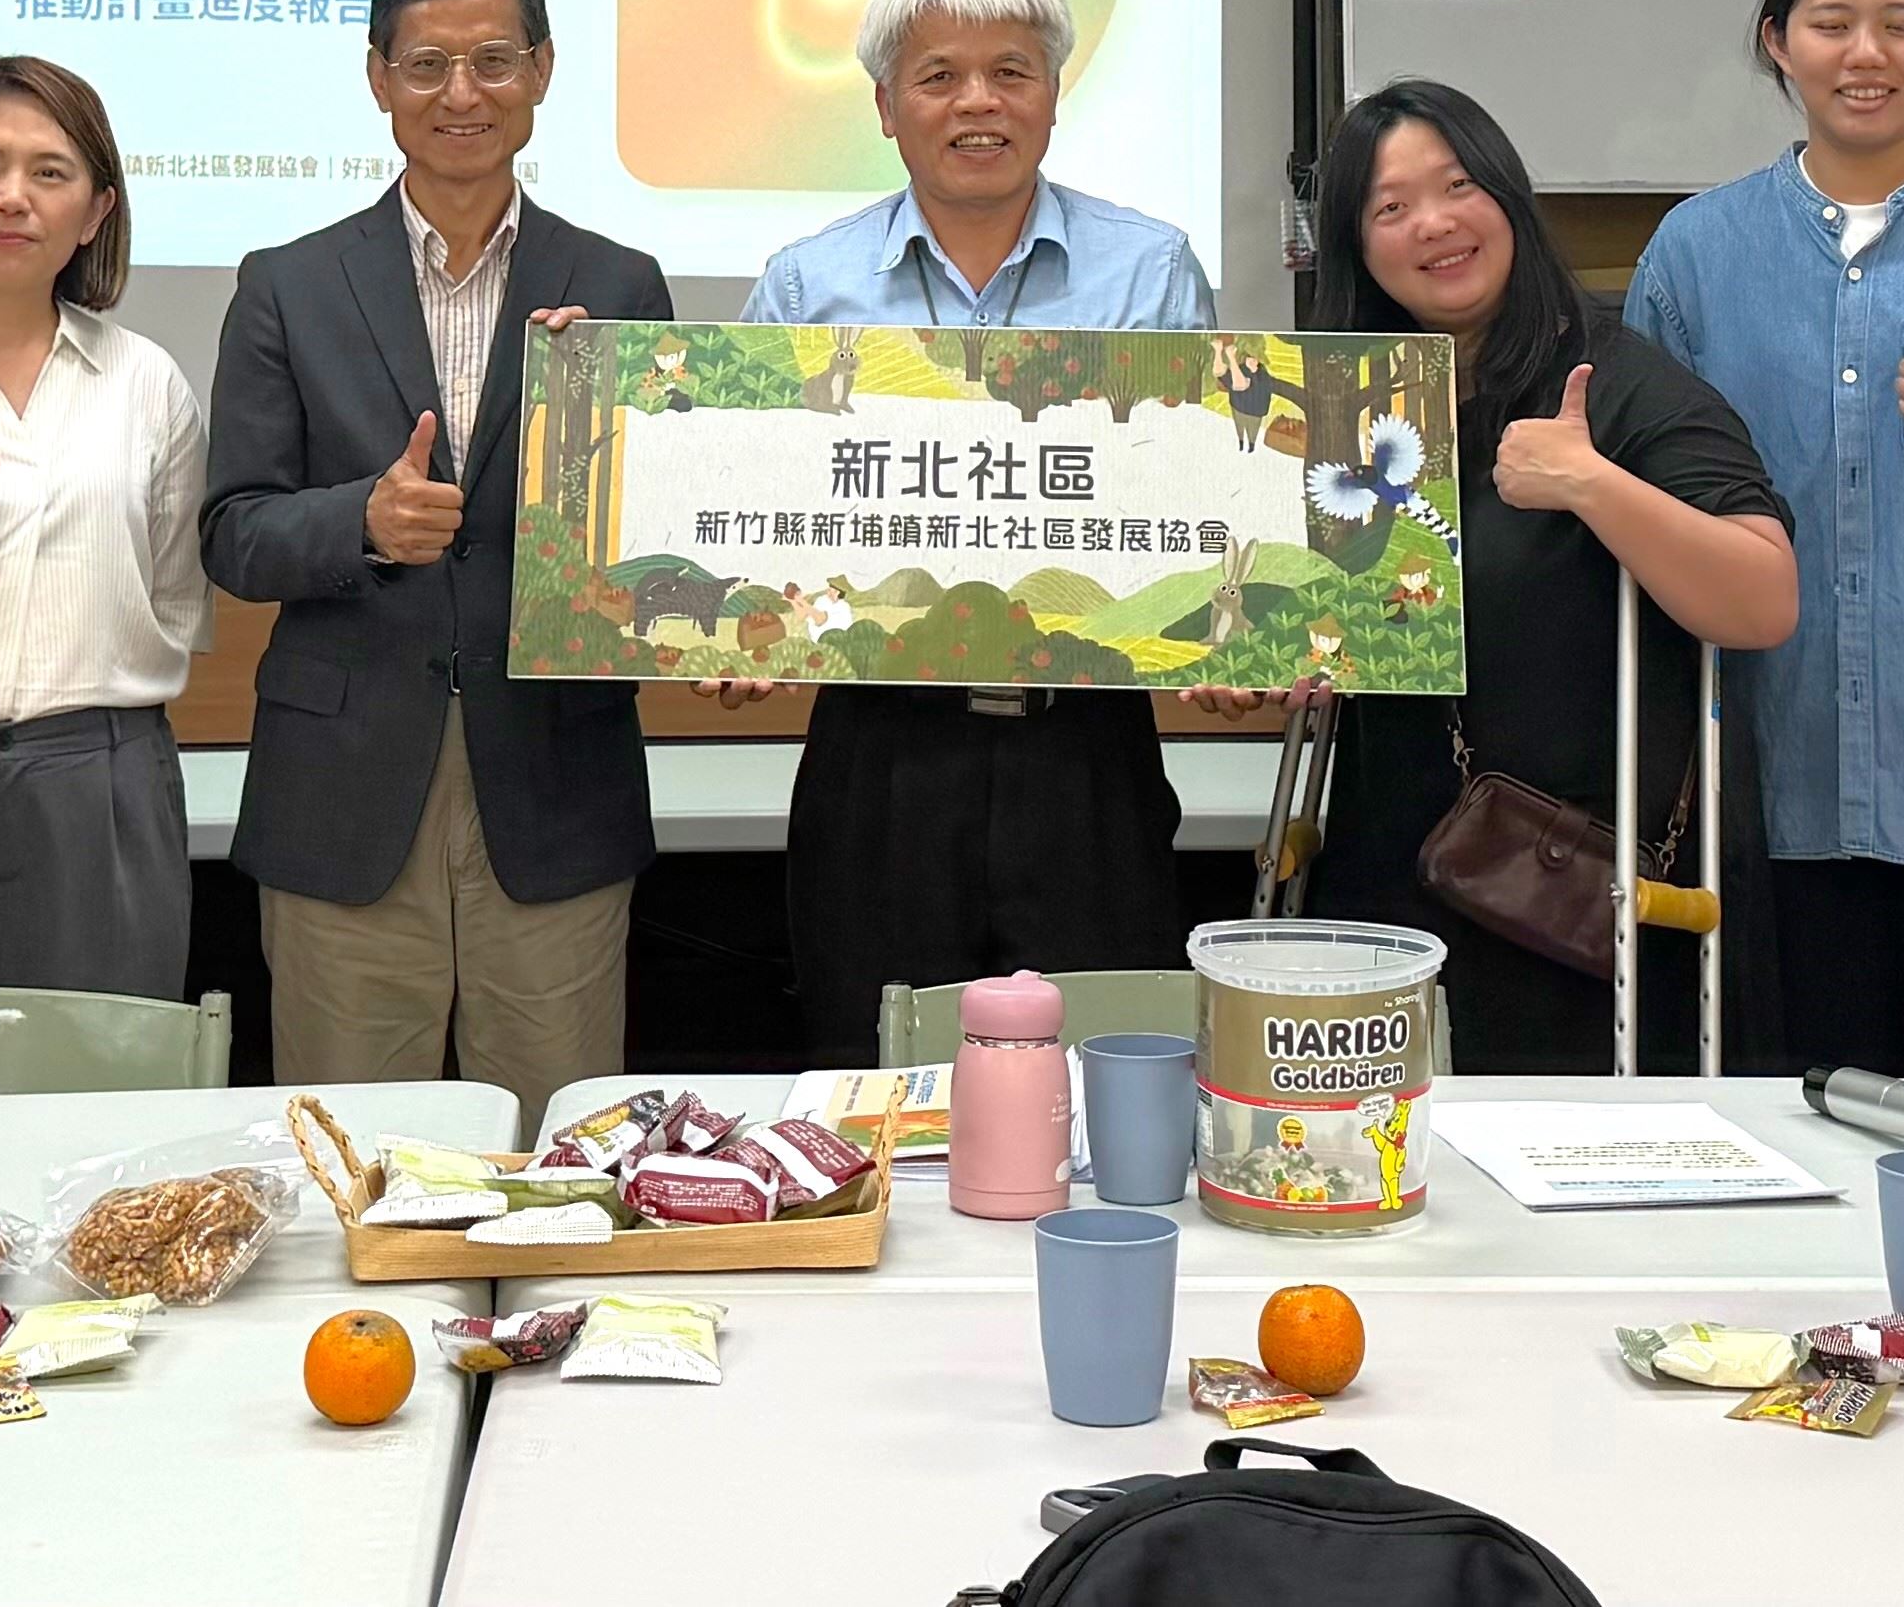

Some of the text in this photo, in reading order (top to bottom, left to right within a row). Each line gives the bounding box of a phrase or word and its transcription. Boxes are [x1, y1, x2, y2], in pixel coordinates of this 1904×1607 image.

[830, 437, 1096, 504] 新北社區
[694, 509, 1231, 555] 新竹縣新埔鎮新北社區發展協會
[1265, 1013, 1409, 1059] HARIBO
[1272, 1062, 1405, 1091] Goldbären
